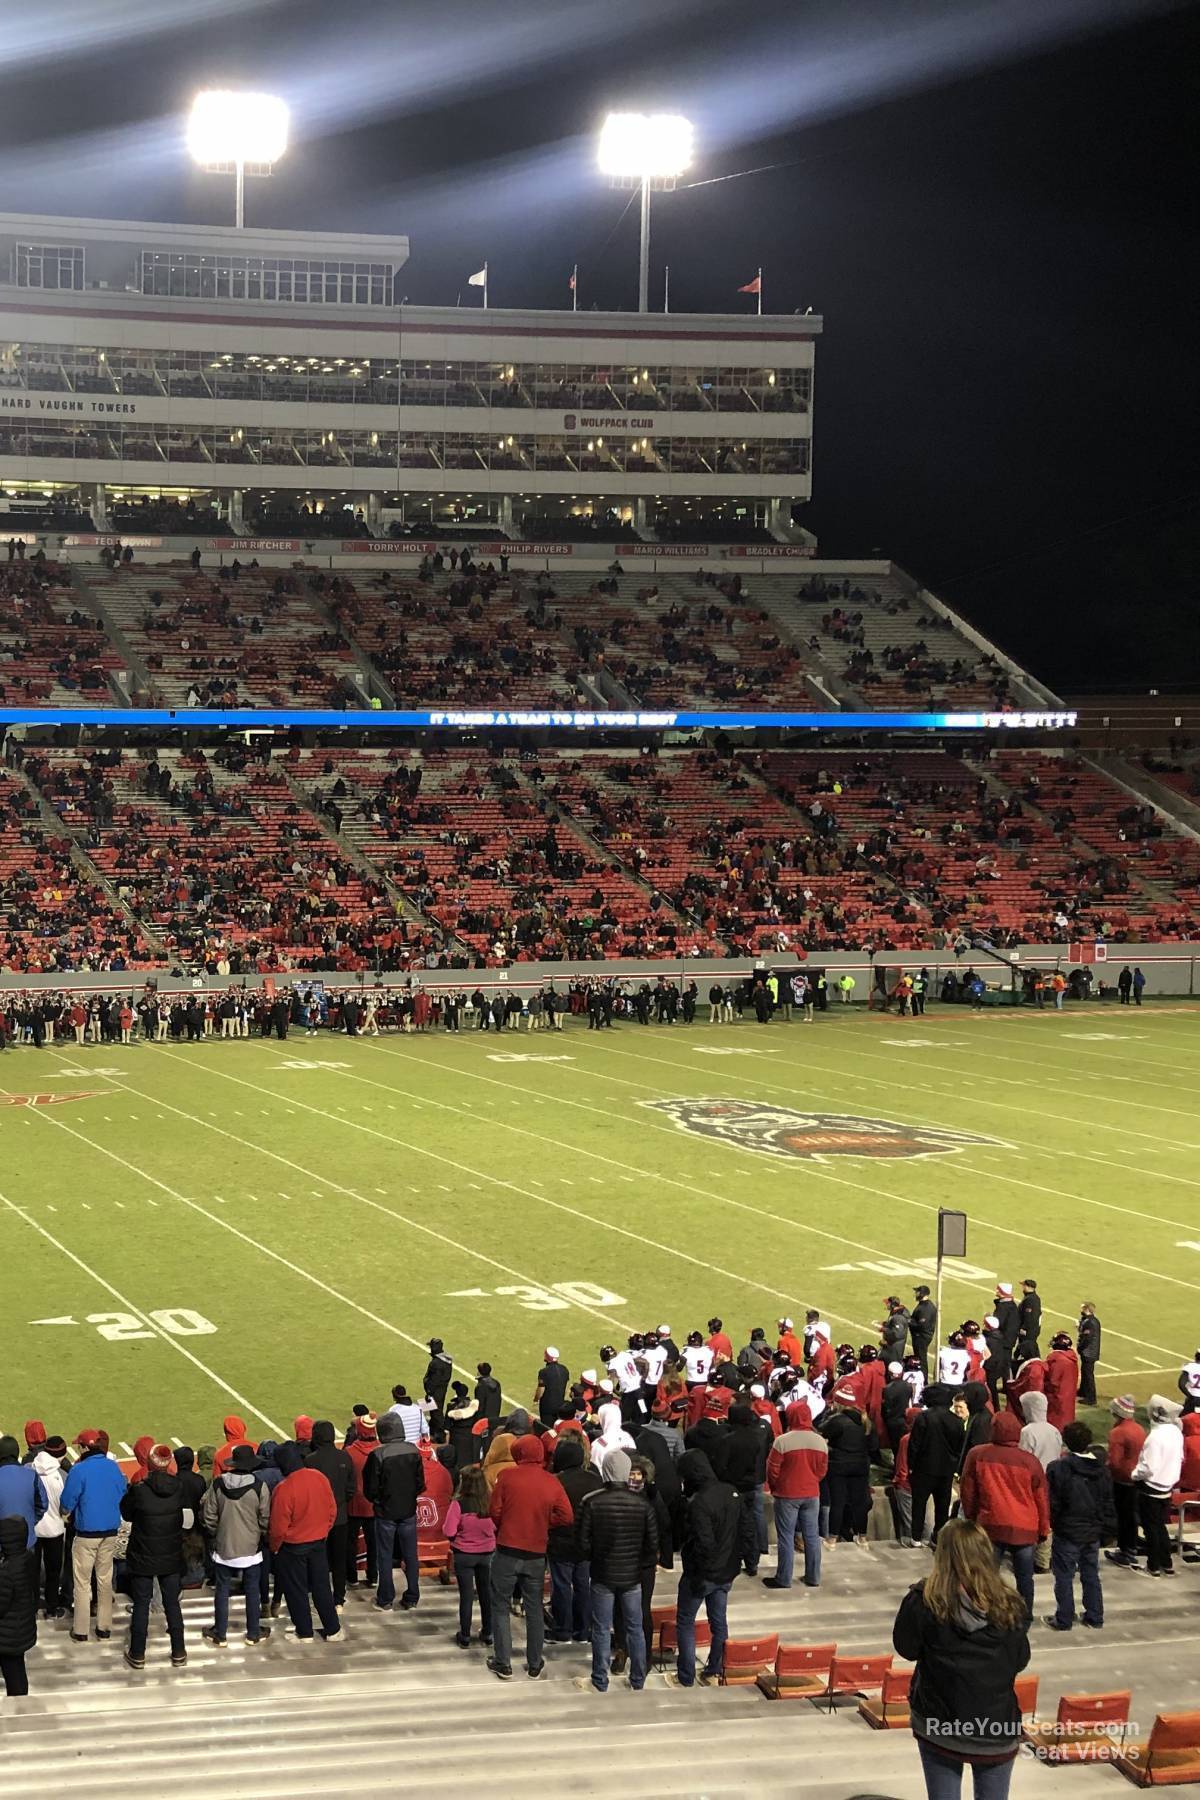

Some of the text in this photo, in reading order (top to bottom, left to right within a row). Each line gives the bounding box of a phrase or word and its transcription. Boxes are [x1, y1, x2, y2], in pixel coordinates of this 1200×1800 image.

[39, 399, 84, 411] VAUGHN
[91, 401, 137, 414] TOWERS
[580, 417, 654, 429] WOLFPACK CLUB
[94, 537, 113, 546] TED
[230, 540, 247, 550] JIM
[368, 543, 428, 553] TORRY HOLT
[500, 544, 569, 554] PHILIP RIVERS
[633, 546, 706, 556] MARIO WILLIAMS
[746, 547, 784, 556] BRADLEY
[495, 713, 508, 725] A
[499, 971, 509, 980] 21
[192, 978, 203, 988] 20
[861, 1257, 998, 1281] 40
[496, 1282, 628, 1310] 30
[86, 1308, 219, 1341] 20
[655, 1361, 662, 1376] 7
[696, 1360, 705, 1375] 5
[950, 1361, 959, 1375] 2
